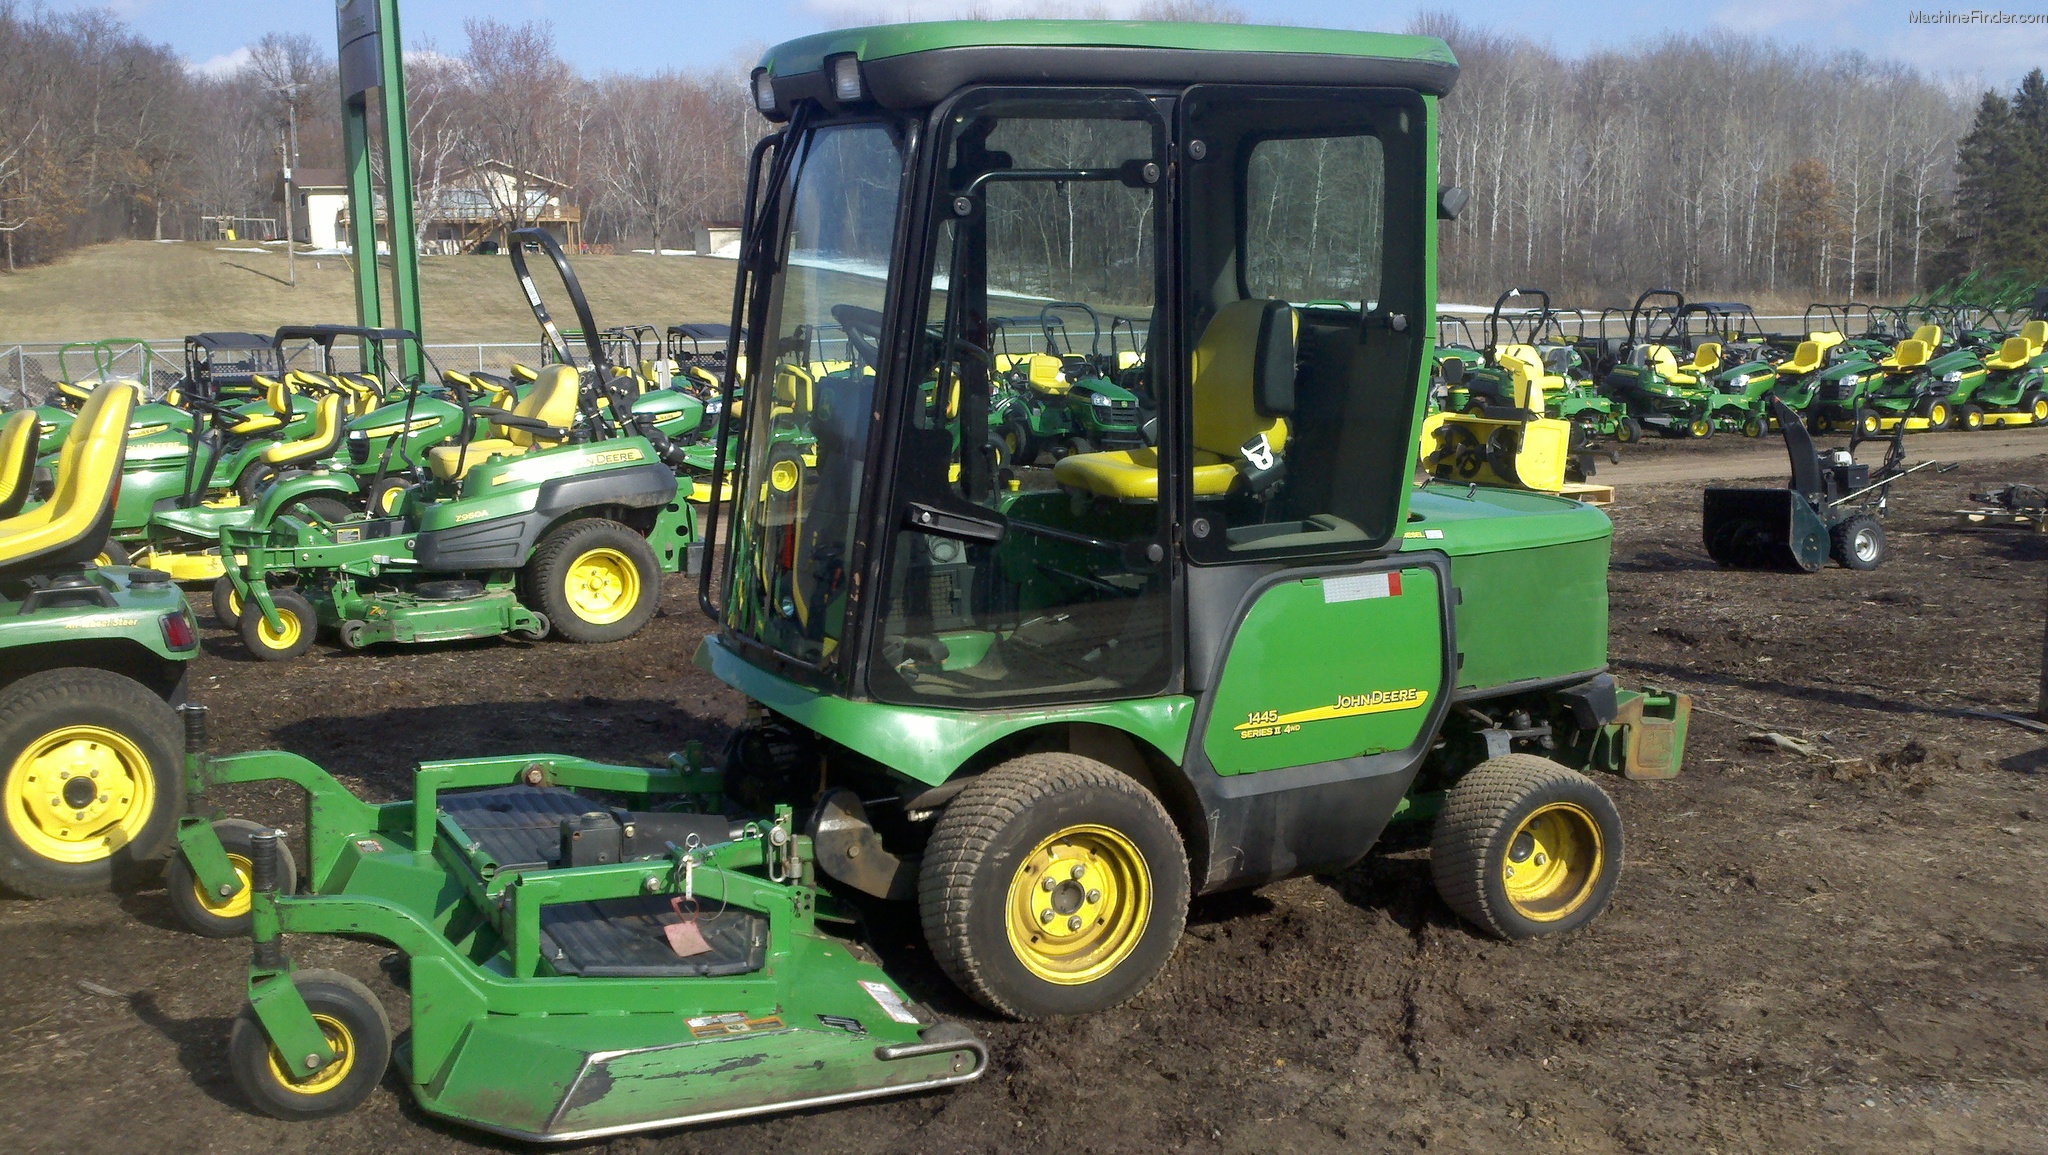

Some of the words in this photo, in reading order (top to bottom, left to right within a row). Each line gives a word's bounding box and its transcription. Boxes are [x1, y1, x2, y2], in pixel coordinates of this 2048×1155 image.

[596, 451, 635, 464] DEERE
[455, 510, 488, 522] Z950A
[112, 618, 138, 627] Steer
[1334, 694, 1371, 709] JOHN
[1371, 688, 1417, 704] DEERE
[1247, 709, 1278, 725] 1445
[1240, 728, 1273, 740] SERIES
